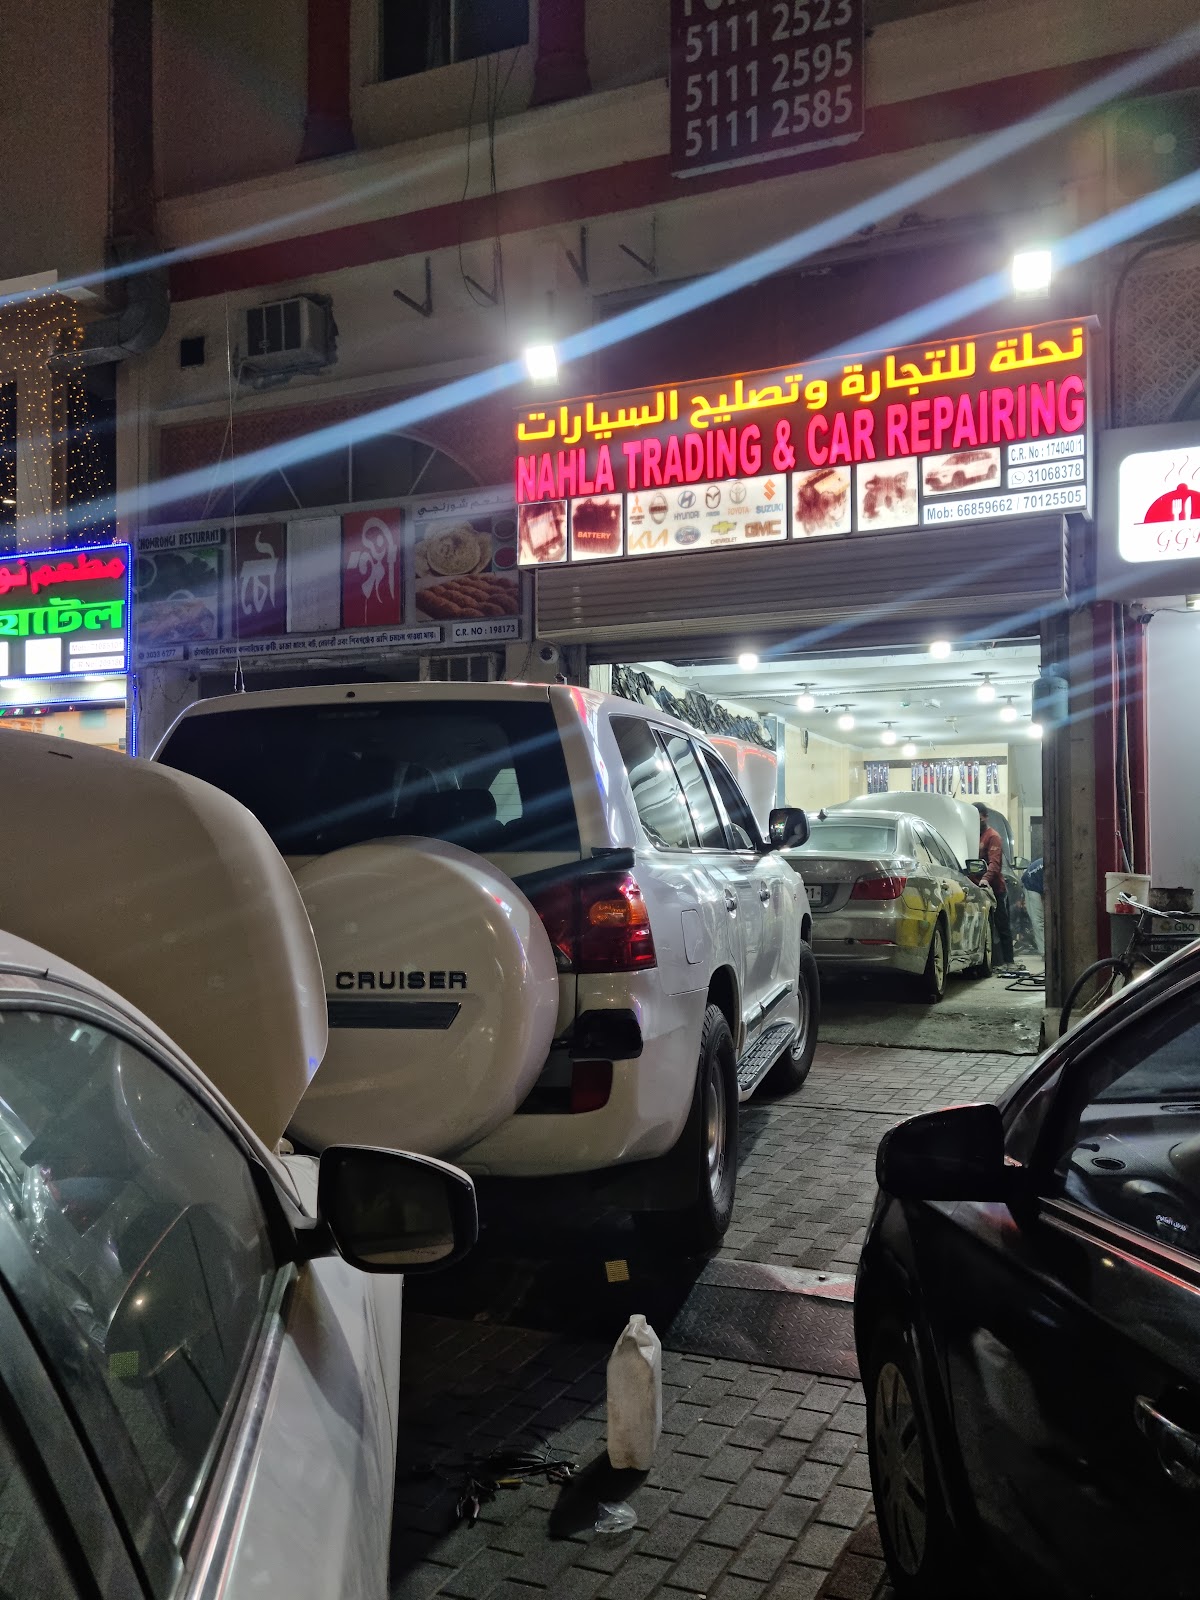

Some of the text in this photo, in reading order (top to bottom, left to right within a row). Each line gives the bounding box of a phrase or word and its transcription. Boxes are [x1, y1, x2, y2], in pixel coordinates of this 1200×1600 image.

[686, 0, 852, 62] 5111 2523
[685, 37, 853, 112] 5111 2595
[685, 84, 853, 157] 5111 2585
[989, 327, 1084, 373] نحلة
[841, 342, 976, 403] للتجارة
[517, 390, 679, 443] السيارات
[516, 374, 1085, 505] NAHLA TRADING & CAR REPAIRING
[1028, 463, 1081, 483] 31068378
[728, 507, 749, 515] TOYOTA
[756, 504, 783, 514] SUZUKI
[927, 508, 953, 521] Mob:
[957, 499, 1013, 517] 66859662
[1024, 490, 1082, 509] 70125505
[179, 529, 219, 546] RESTURANT
[578, 531, 611, 539] BATTERY
[711, 537, 737, 545] CHEVROLET
[745, 520, 781, 538] GMC
[31, 553, 125, 594] مطعم
[455, 628, 469, 637] C.R.
[471, 627, 483, 635] NO
[490, 624, 516, 634] 198173
[336, 971, 468, 990] CRUISER
